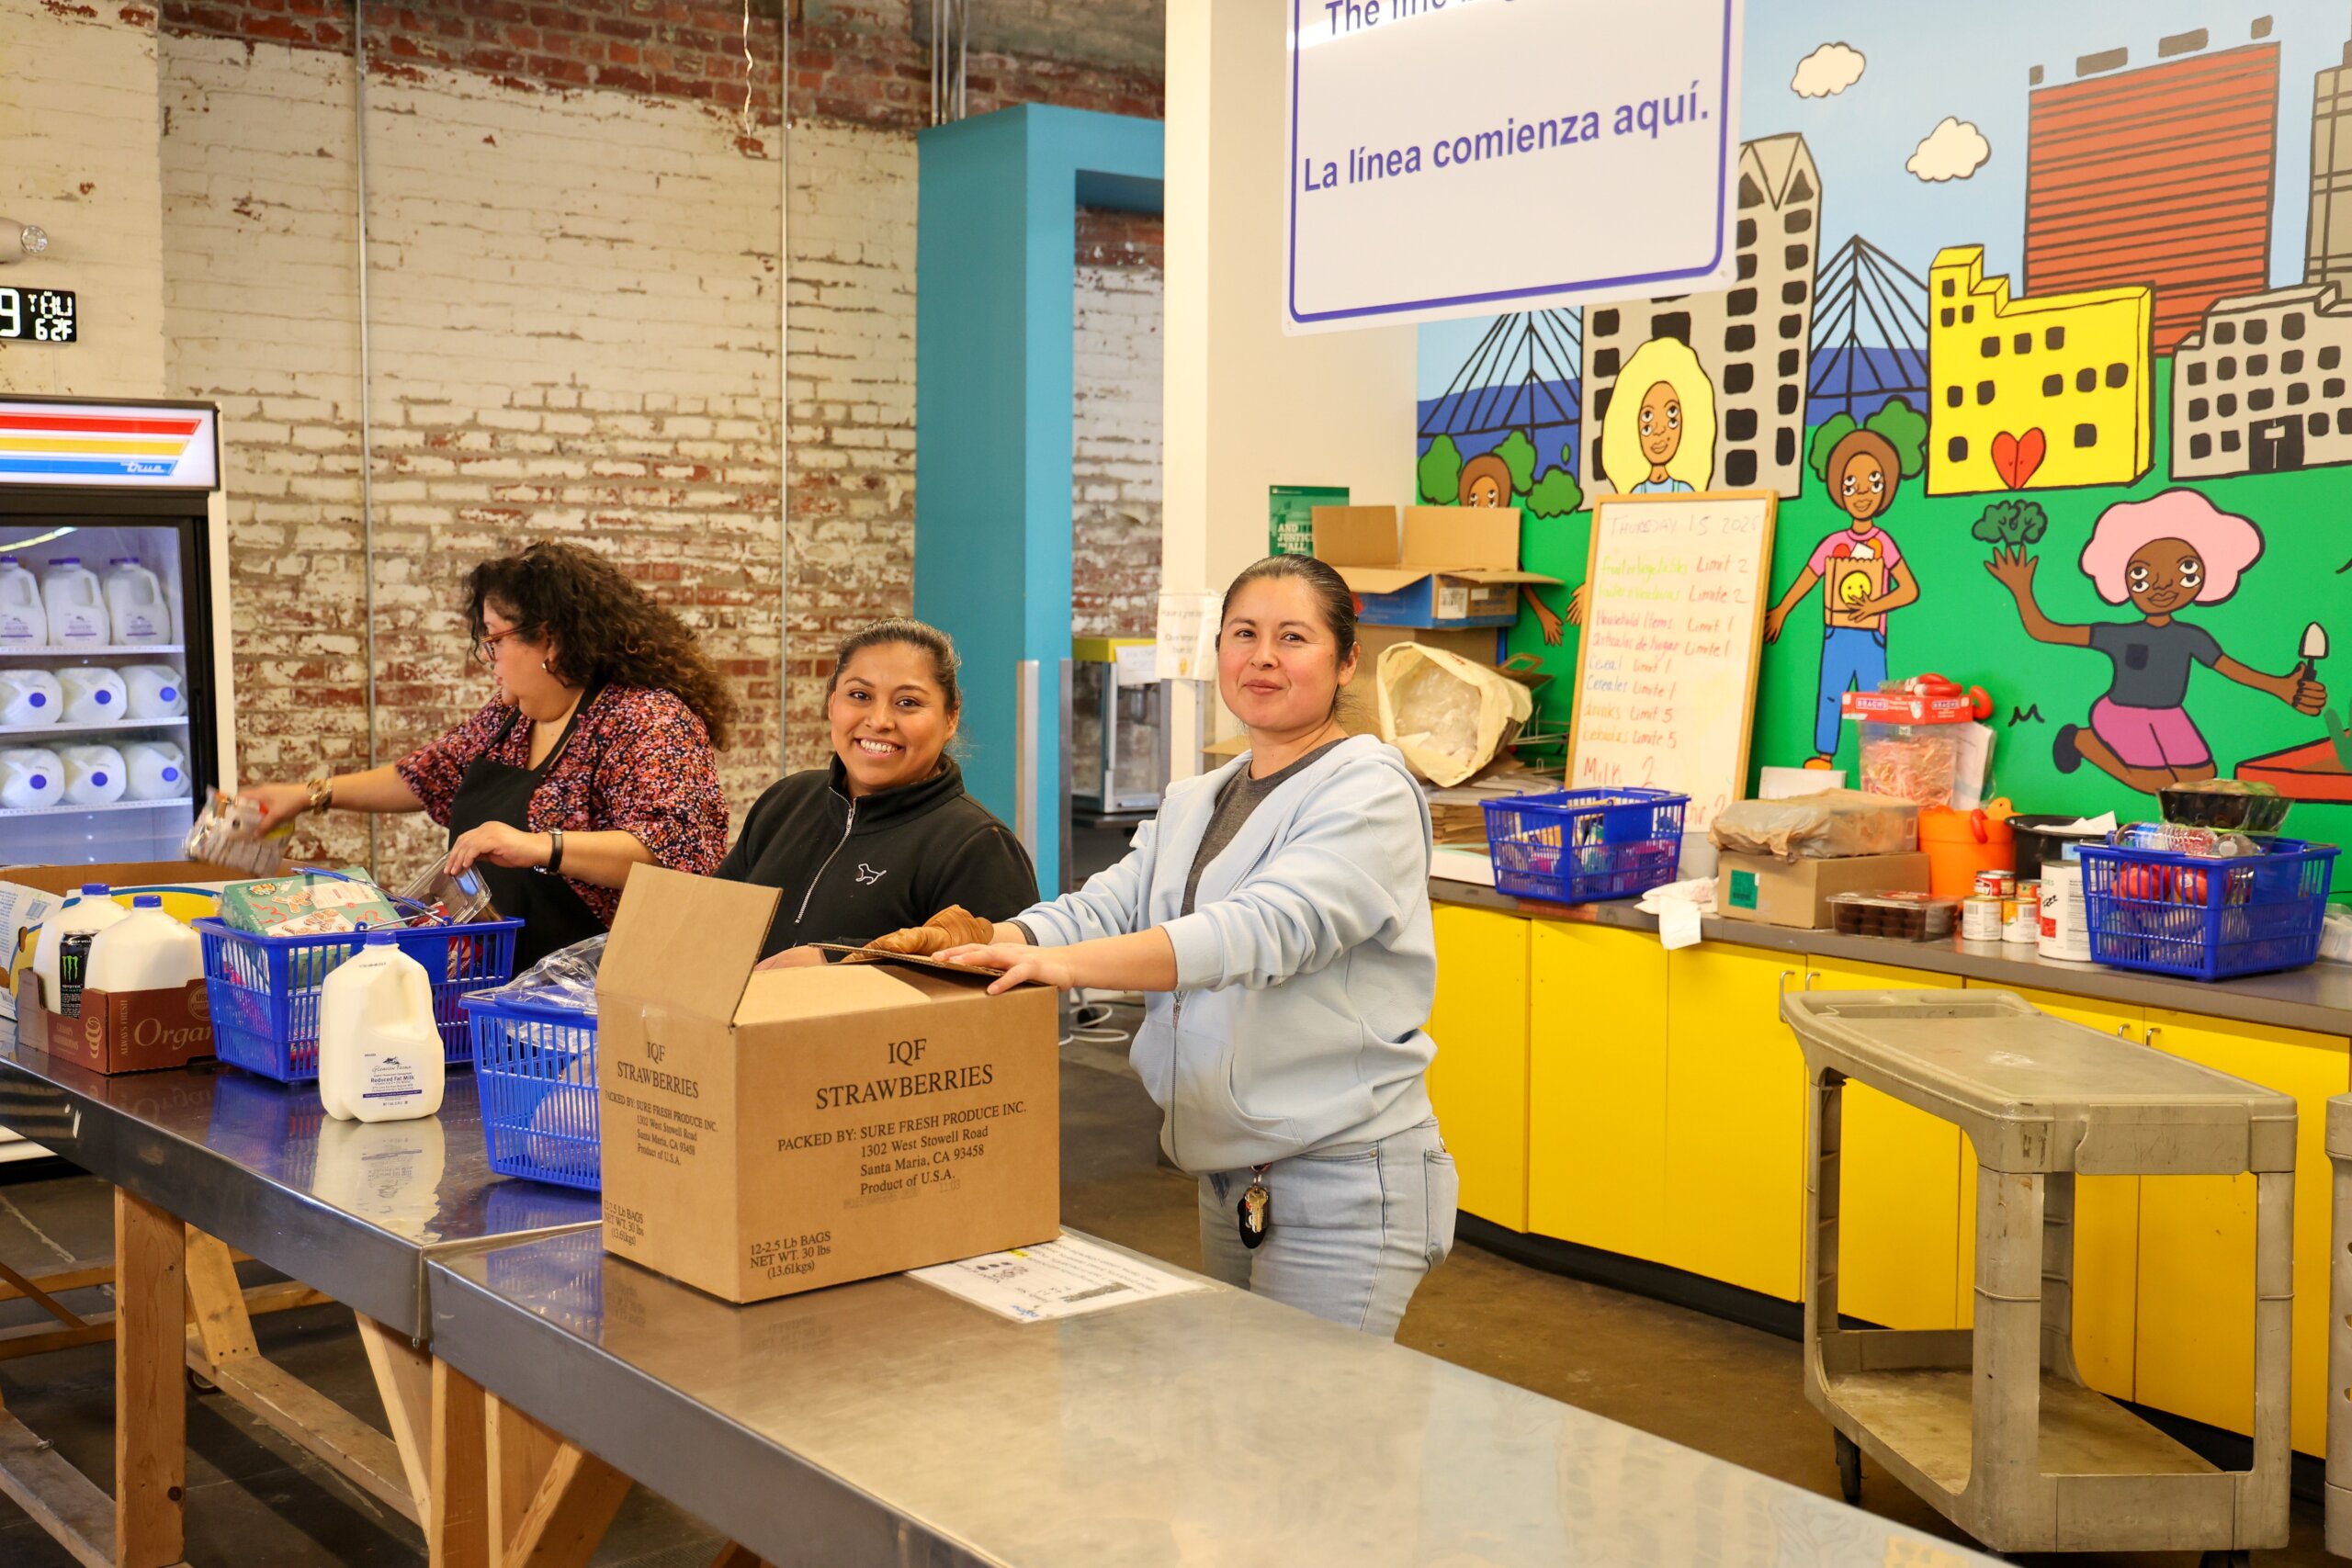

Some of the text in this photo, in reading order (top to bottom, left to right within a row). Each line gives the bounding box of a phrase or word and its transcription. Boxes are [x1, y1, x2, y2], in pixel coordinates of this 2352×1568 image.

[1325, 0, 1379, 35] The
[1305, 79, 1709, 192] La línea comienza aquí.
[1278, 524, 1298, 533] AND
[1607, 514, 1677, 536] THURSDAY
[1689, 514, 1712, 536] 15
[1278, 533, 1312, 542] JUSTIC
[1288, 542, 1306, 551] ALL
[1696, 554, 1731, 573] Limit
[1738, 558, 1749, 573] 2
[1688, 584, 1728, 604] Limite
[1733, 588, 1748, 604] 2
[1687, 616, 1720, 633] Limit
[1684, 640, 1721, 658] Limite
[1633, 658, 1659, 673] Limit
[1633, 681, 1665, 698] Limite
[1630, 705, 1657, 721] Limit
[1661, 707, 1673, 723] 5
[1632, 729, 1664, 746] Limite
[1668, 731, 1678, 750] 5
[647, 1041, 665, 1065] IQF
[888, 1038, 927, 1066] IQF
[617, 1060, 699, 1100] STRAWBERRIES
[816, 1064, 993, 1110] STRAWBERRIES
[605, 1090, 626, 1105] ACKED
[636, 1100, 651, 1114] SURE
[653, 1104, 673, 1119] FRESH
[673, 1111, 703, 1129] PRODUCE
[777, 1100, 1026, 1152] PACKED BY: SURE FRESH PRODUCE INC.
[669, 1140, 679, 1151] CA
[861, 1125, 989, 1158] 1302 West Stowell Road
[860, 1163, 891, 1177] Santa
[933, 1150, 950, 1164] CA
[954, 1144, 985, 1160] 93458
[860, 1168, 956, 1195] Product of U.S.A.
[627, 1208, 643, 1224] BAGS
[628, 1221, 636, 1233] 30
[751, 1231, 831, 1256] 12-2.5 Lb BAGS
[750, 1245, 831, 1269] NET WT. 30 lbs
